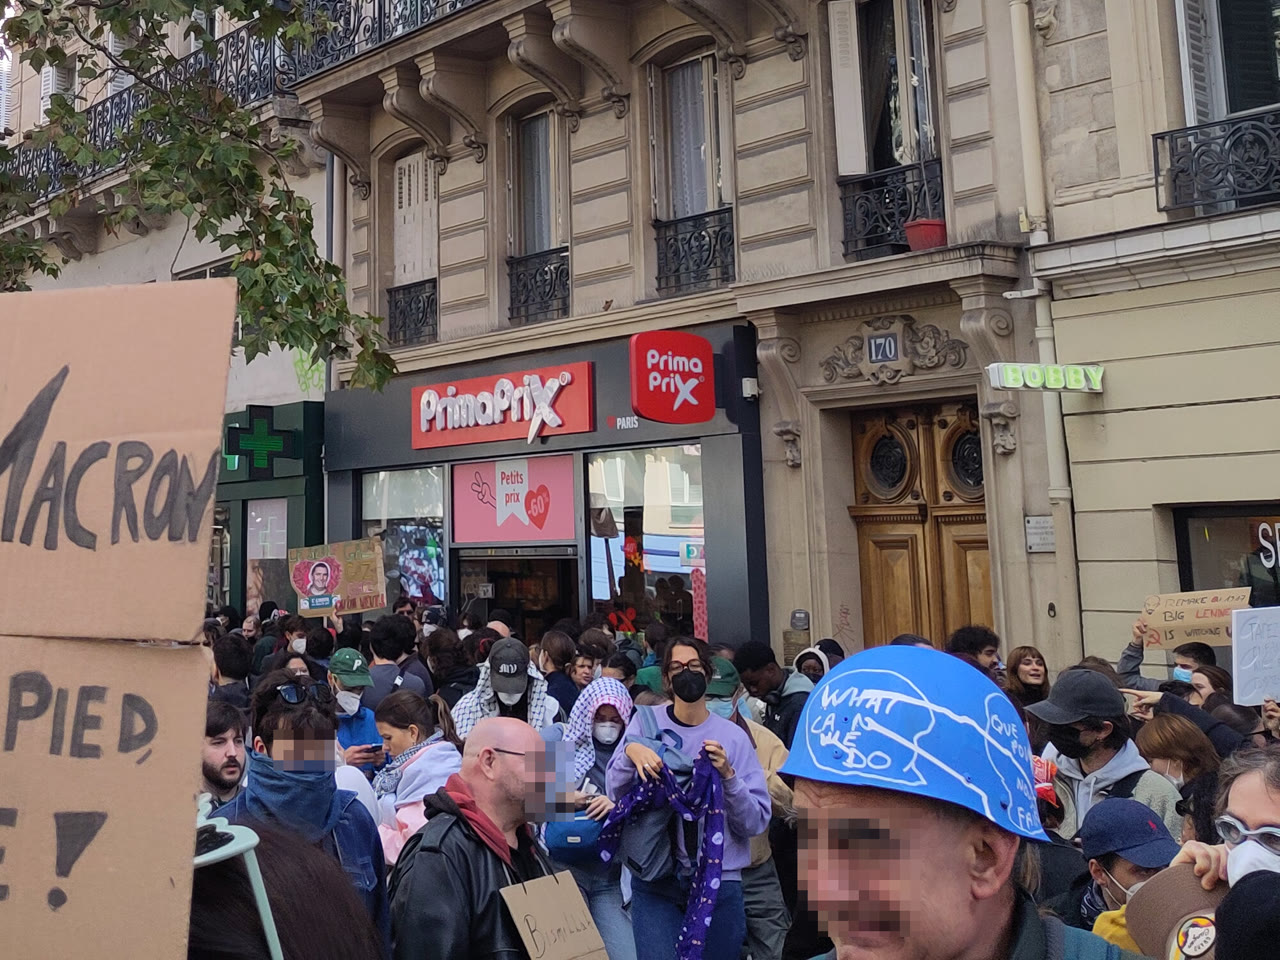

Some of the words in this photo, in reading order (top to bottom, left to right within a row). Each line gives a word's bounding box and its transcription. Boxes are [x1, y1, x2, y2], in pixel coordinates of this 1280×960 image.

[871, 337, 895, 360] 170
[646, 349, 703, 373] Prima
[1003, 365, 1104, 389] BOBBY
[616, 416, 638, 429] PARIS
[500, 470, 524, 485] Petits
[505, 488, 520, 507] prix
[1165, 596, 1207, 607] REMAKE
[1163, 611, 1185, 622] BIG
[1164, 629, 1174, 640] IS
[353, 659, 362, 671] P
[821, 685, 897, 714] WHAT
[811, 713, 873, 733] CAN
[991, 714, 1018, 739] QUE
[820, 731, 861, 747] WE
[842, 747, 891, 769] DO
[47, 811, 107, 911] !
